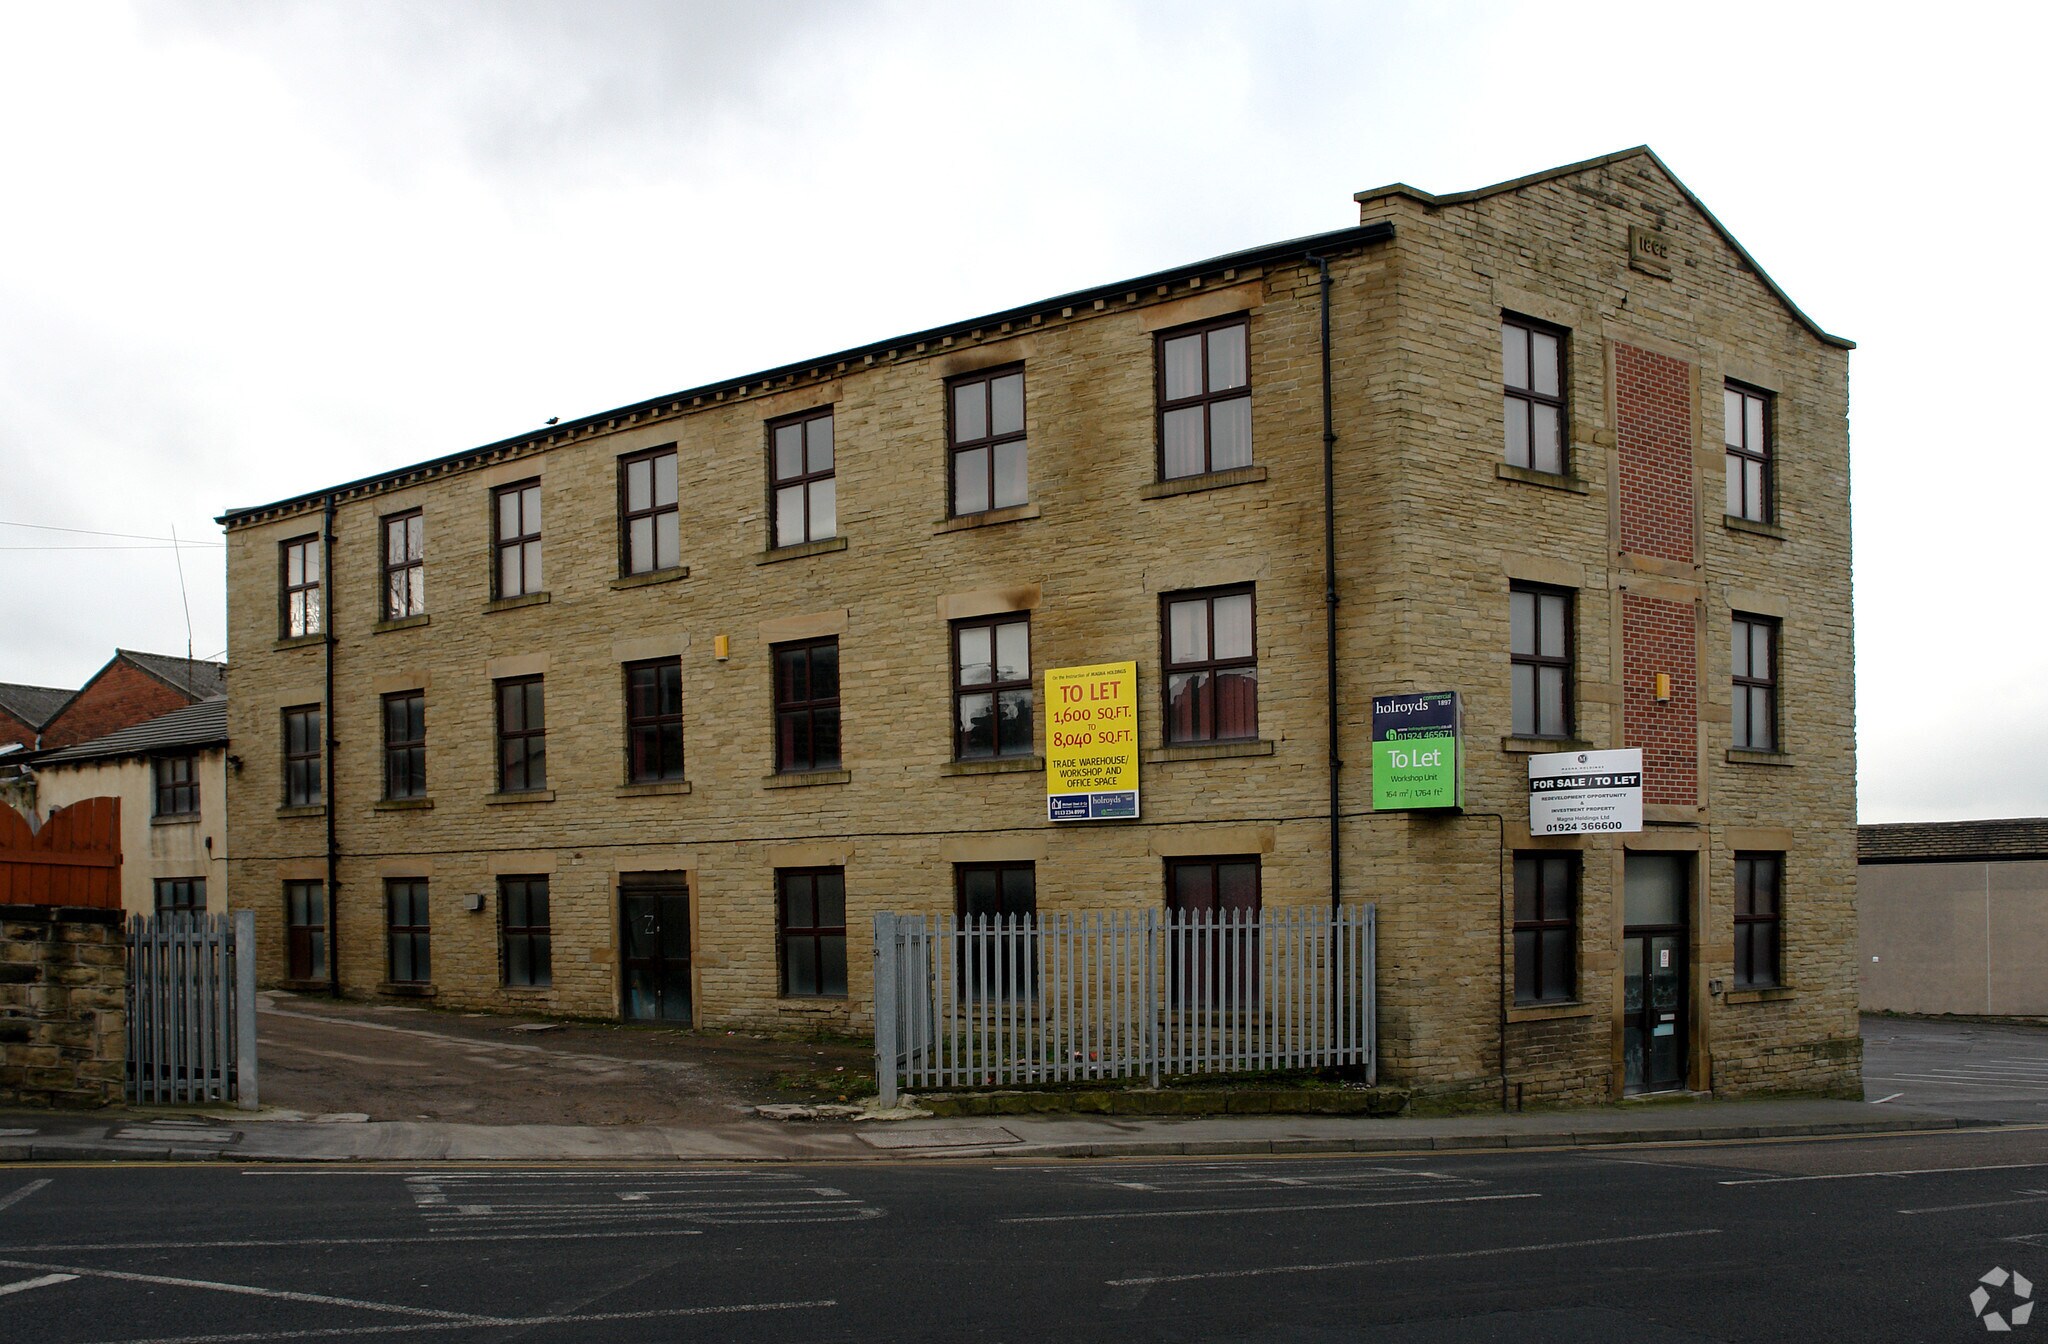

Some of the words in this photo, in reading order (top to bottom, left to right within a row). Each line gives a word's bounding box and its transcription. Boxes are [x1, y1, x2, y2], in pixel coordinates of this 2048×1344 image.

[1060, 685, 1083, 703] TO
[1090, 681, 1121, 700] LET
[1376, 698, 1428, 715] holroyds
[1054, 707, 1091, 725] 1,600
[1098, 706, 1131, 720] SQ.FT.
[1054, 732, 1092, 748] 8,040
[1099, 730, 1132, 744] SQ.FT.
[1398, 732, 1422, 740] 01924
[1424, 730, 1452, 738] 465671
[1053, 759, 1076, 768] TRADE
[1079, 755, 1129, 766] WAREHOUSE/
[1387, 750, 1408, 768] To
[1413, 749, 1441, 767] Let
[1060, 768, 1102, 778] WORKSHOP
[1067, 779, 1091, 787] OFFICE
[1094, 777, 1117, 786] SPACE
[1533, 780, 1554, 789] FOR
[1557, 778, 1585, 787] SALE
[1588, 778, 1592, 786] /
[1595, 777, 1611, 785] TO
[1614, 776, 1637, 784] LET
[1093, 796, 1121, 805] holroyds
[1546, 823, 1577, 832] 01924
[1581, 822, 1622, 830] 366600
